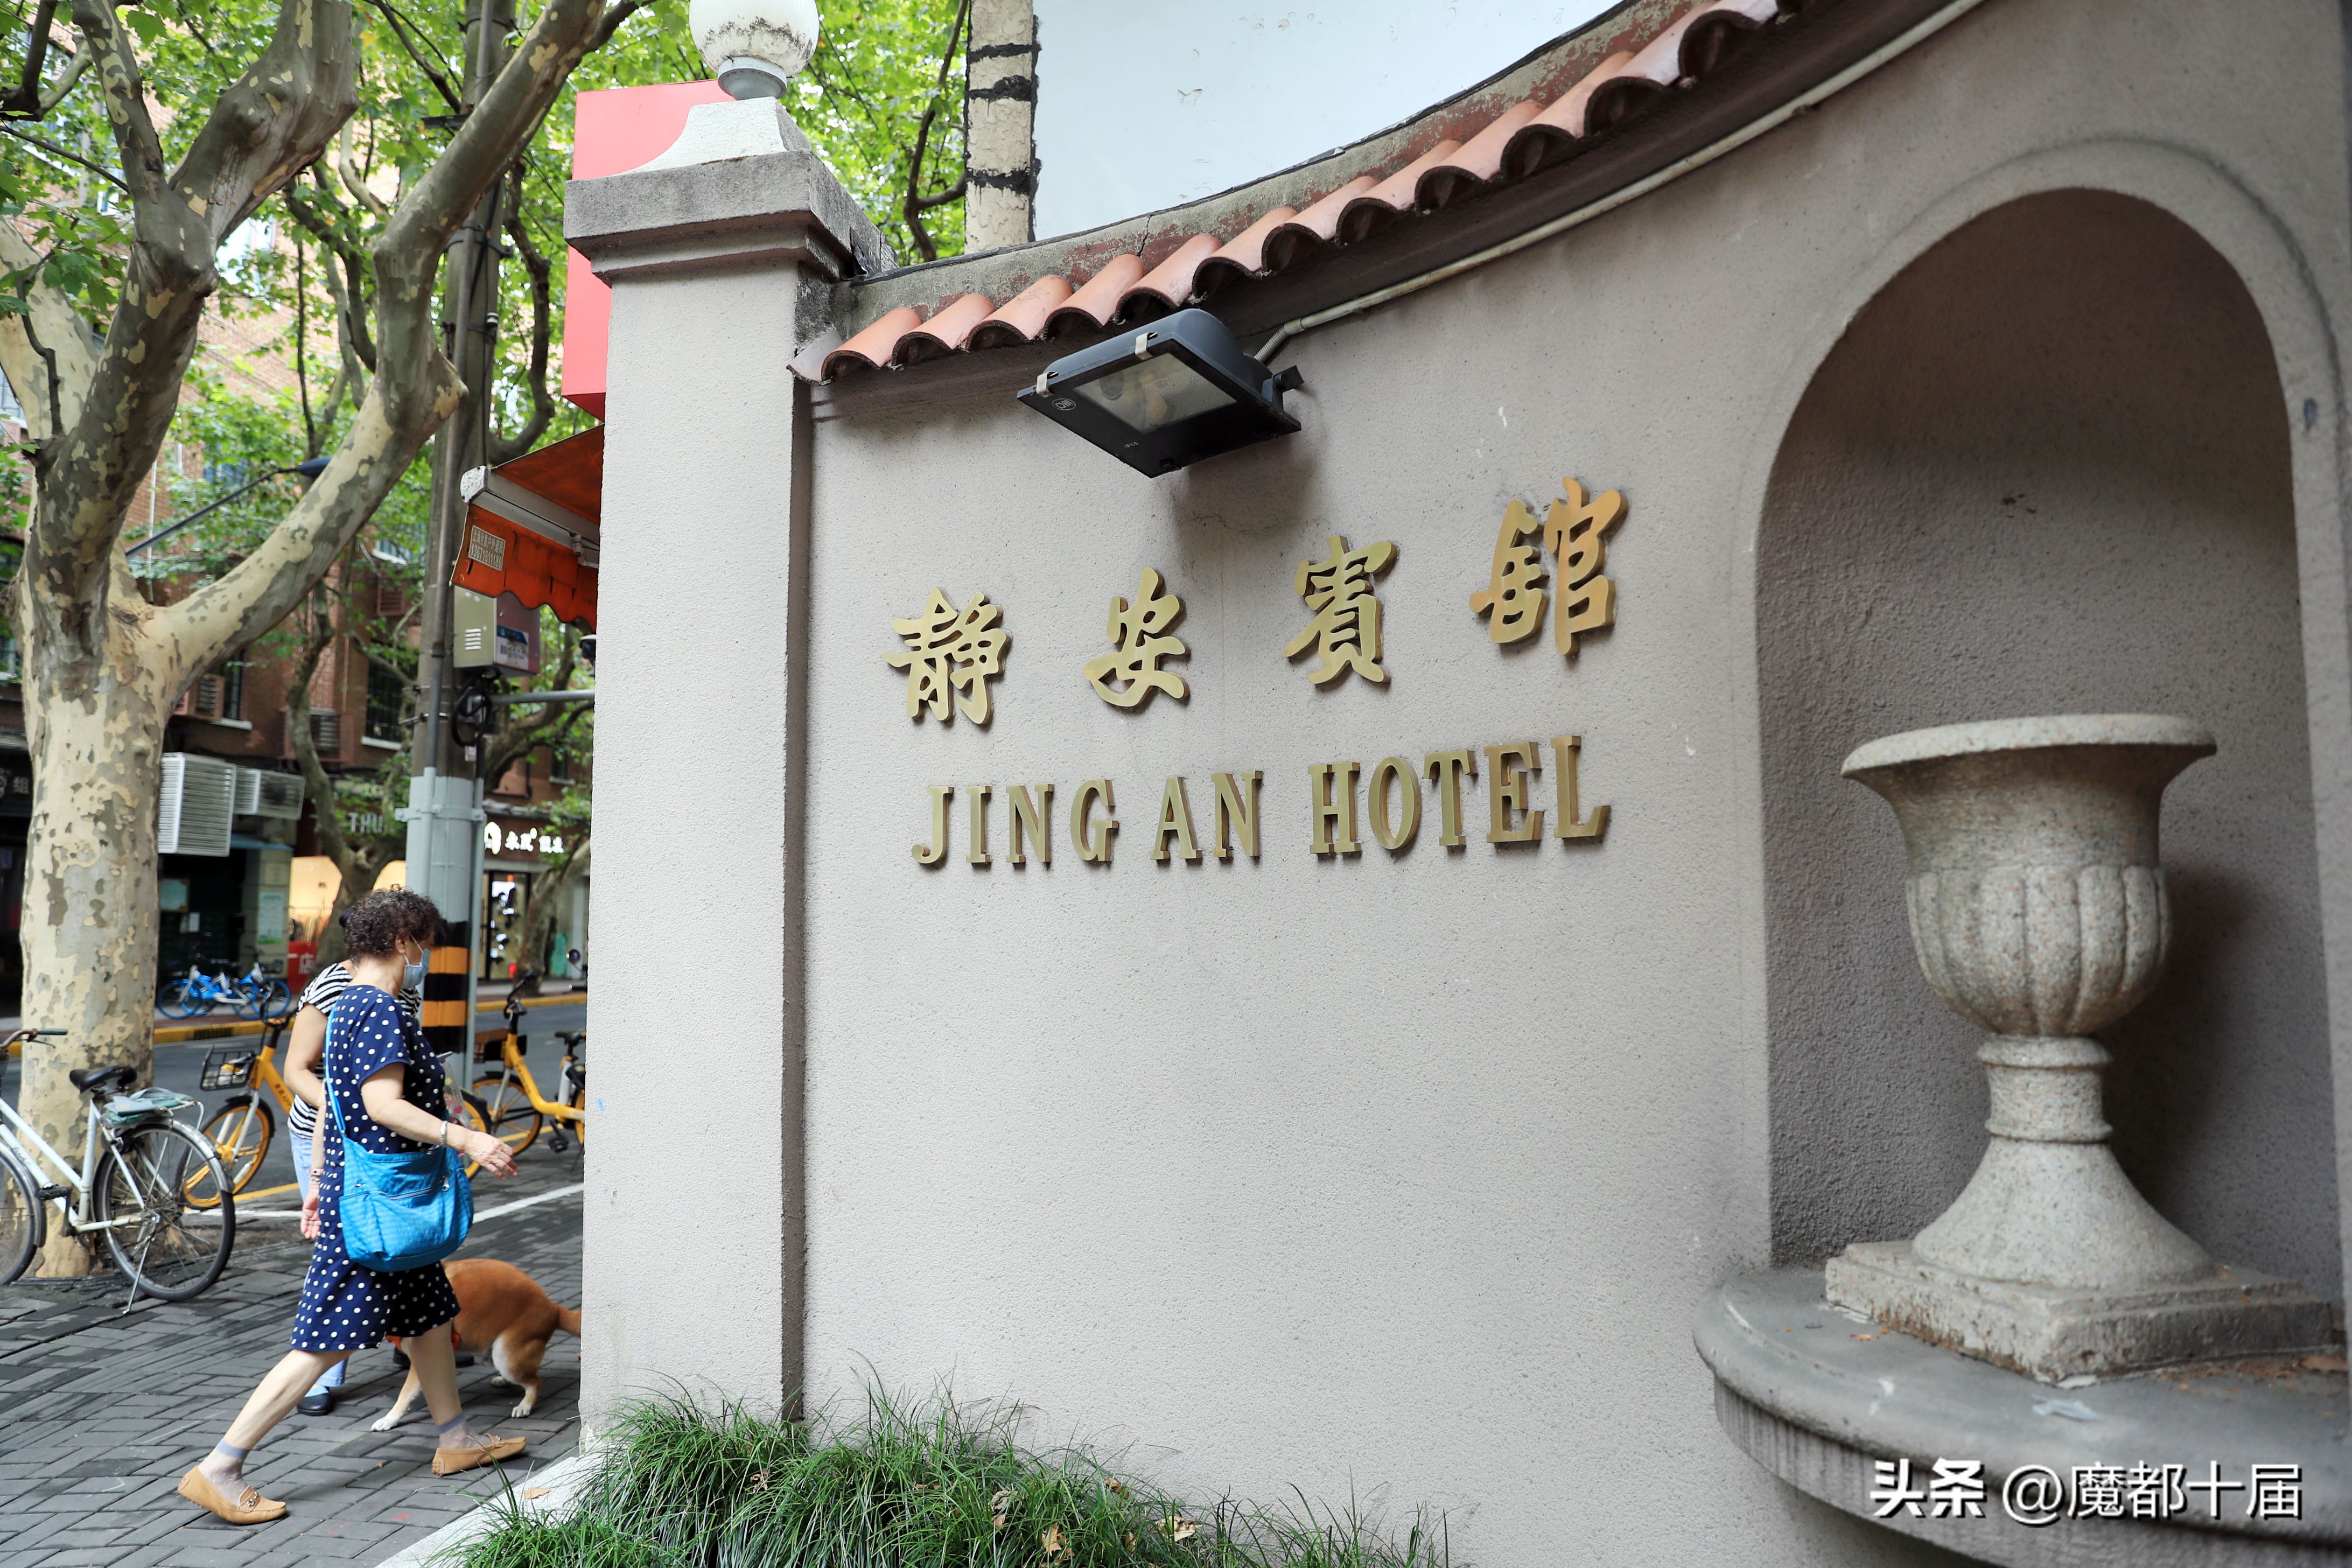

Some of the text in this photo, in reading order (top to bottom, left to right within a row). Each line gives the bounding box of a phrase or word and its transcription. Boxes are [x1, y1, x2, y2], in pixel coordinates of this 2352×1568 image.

[912, 736, 1611, 864] JING AN HOTEL
